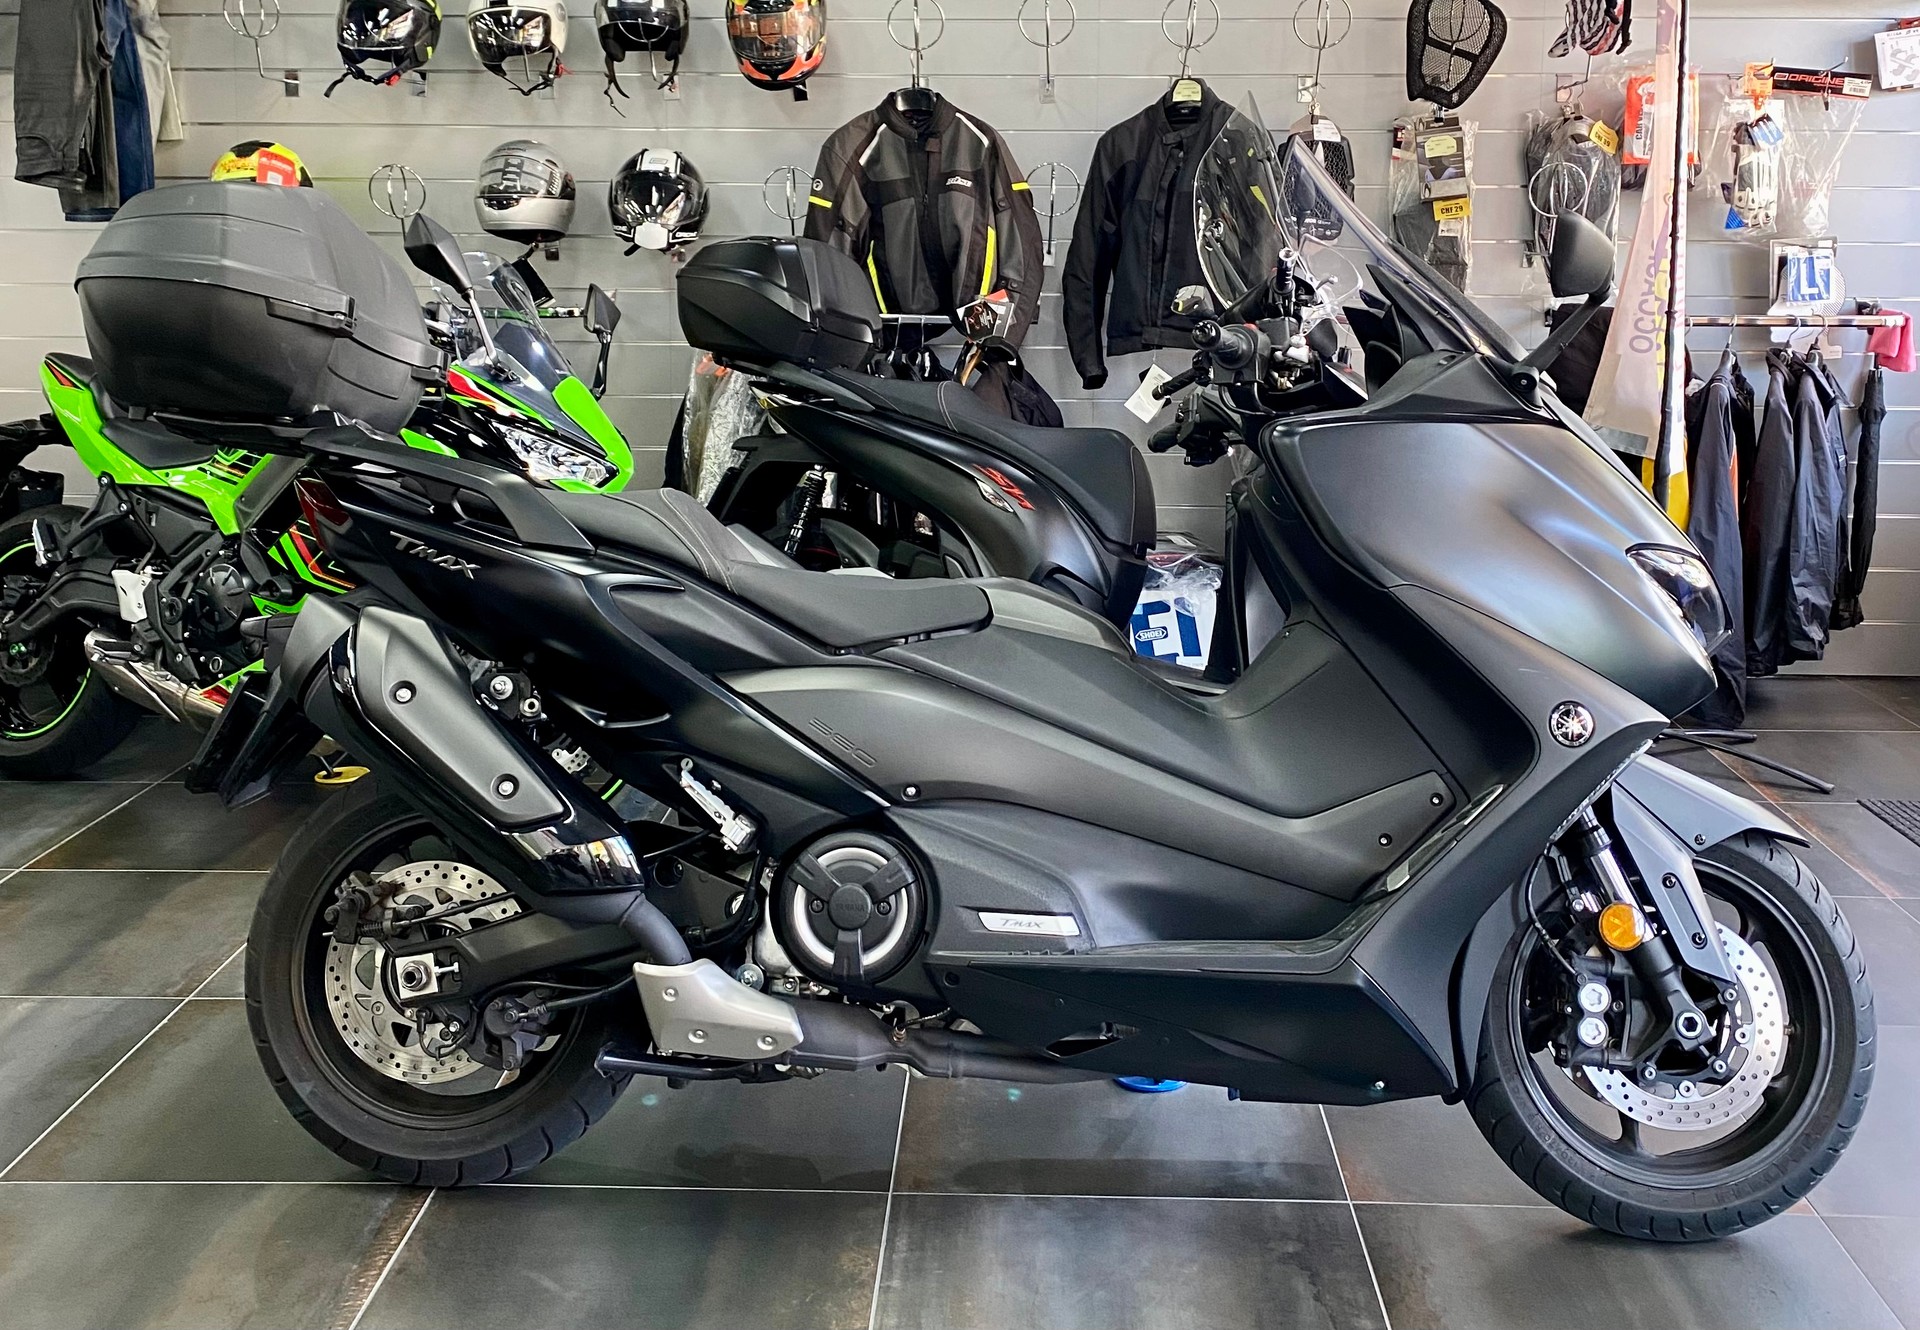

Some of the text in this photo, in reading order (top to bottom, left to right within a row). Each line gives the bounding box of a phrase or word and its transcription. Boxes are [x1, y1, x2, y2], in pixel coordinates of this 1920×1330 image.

[1788, 73, 1845, 86] ORIGINE
[1440, 205, 1464, 215] CHF 29
[1800, 258, 1819, 294] L
[390, 530, 481, 580] TMAX
[1140, 629, 1163, 639] SHOEI
[808, 716, 878, 768] 530
